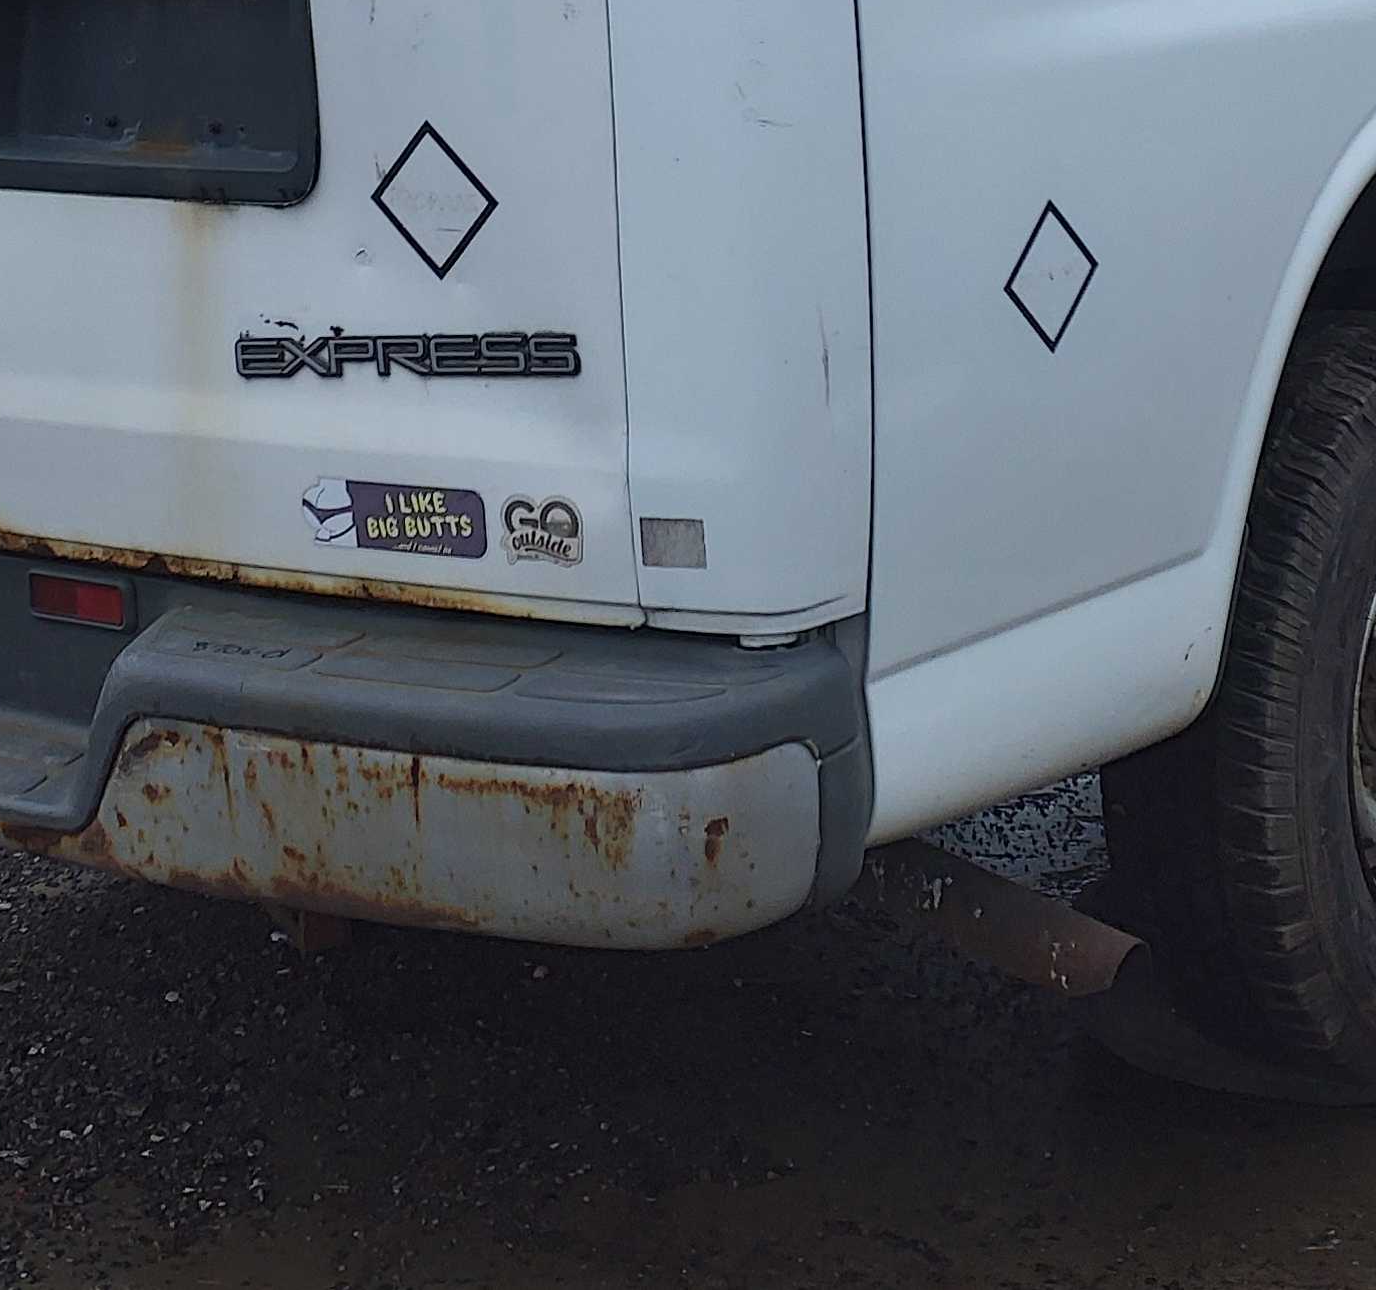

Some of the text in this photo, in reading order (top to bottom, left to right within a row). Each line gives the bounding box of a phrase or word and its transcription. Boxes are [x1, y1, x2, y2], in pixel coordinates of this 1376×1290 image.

[234, 332, 582, 379] EXPRESS
[385, 490, 447, 514] I LIKE
[366, 514, 473, 539] BIG BUTTS
[504, 500, 579, 538] GO
[512, 530, 572, 558] outside
